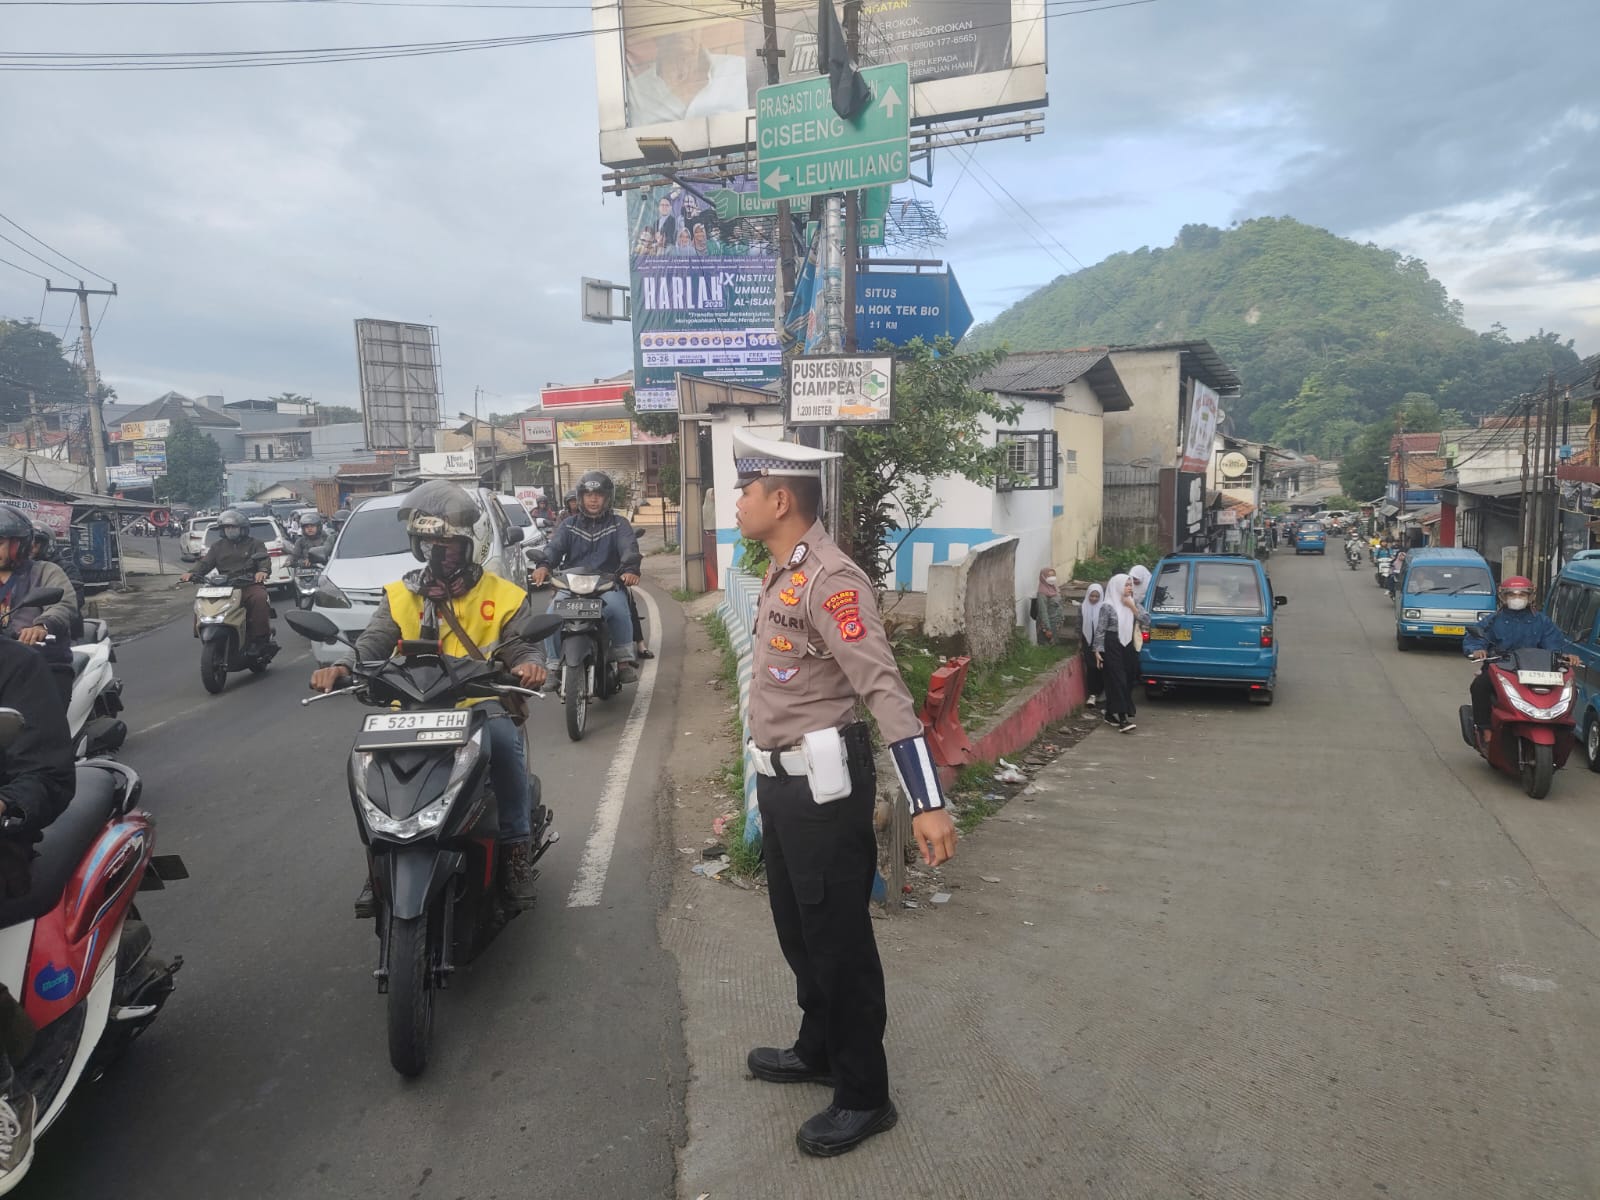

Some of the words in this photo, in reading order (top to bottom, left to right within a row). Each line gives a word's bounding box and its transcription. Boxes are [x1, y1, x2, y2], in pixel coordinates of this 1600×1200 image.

[896, 20, 973, 42] TENGGOROKAN
[928, 55, 958, 65] KEPADA
[952, 61, 974, 72] HAMIL
[760, 91, 812, 119] PRASASTI
[761, 117, 844, 149] CISEENG
[796, 151, 903, 187] LEUWILIANG
[643, 276, 723, 310] HARLAH
[865, 288, 897, 298] SITUS
[868, 305, 891, 315] HOK
[896, 305, 917, 316] TEK
[920, 306, 940, 316] BIO
[885, 321, 898, 329] KM
[794, 361, 862, 379] PUSKESMAS
[793, 381, 855, 396] CIAMPEA
[825, 591, 855, 608] POLRES
[832, 598, 852, 609] BOGOR
[768, 610, 804, 630] POLRI
[368, 718, 378, 730] F
[388, 715, 425, 729] 5231
[436, 714, 466, 727] FHW
